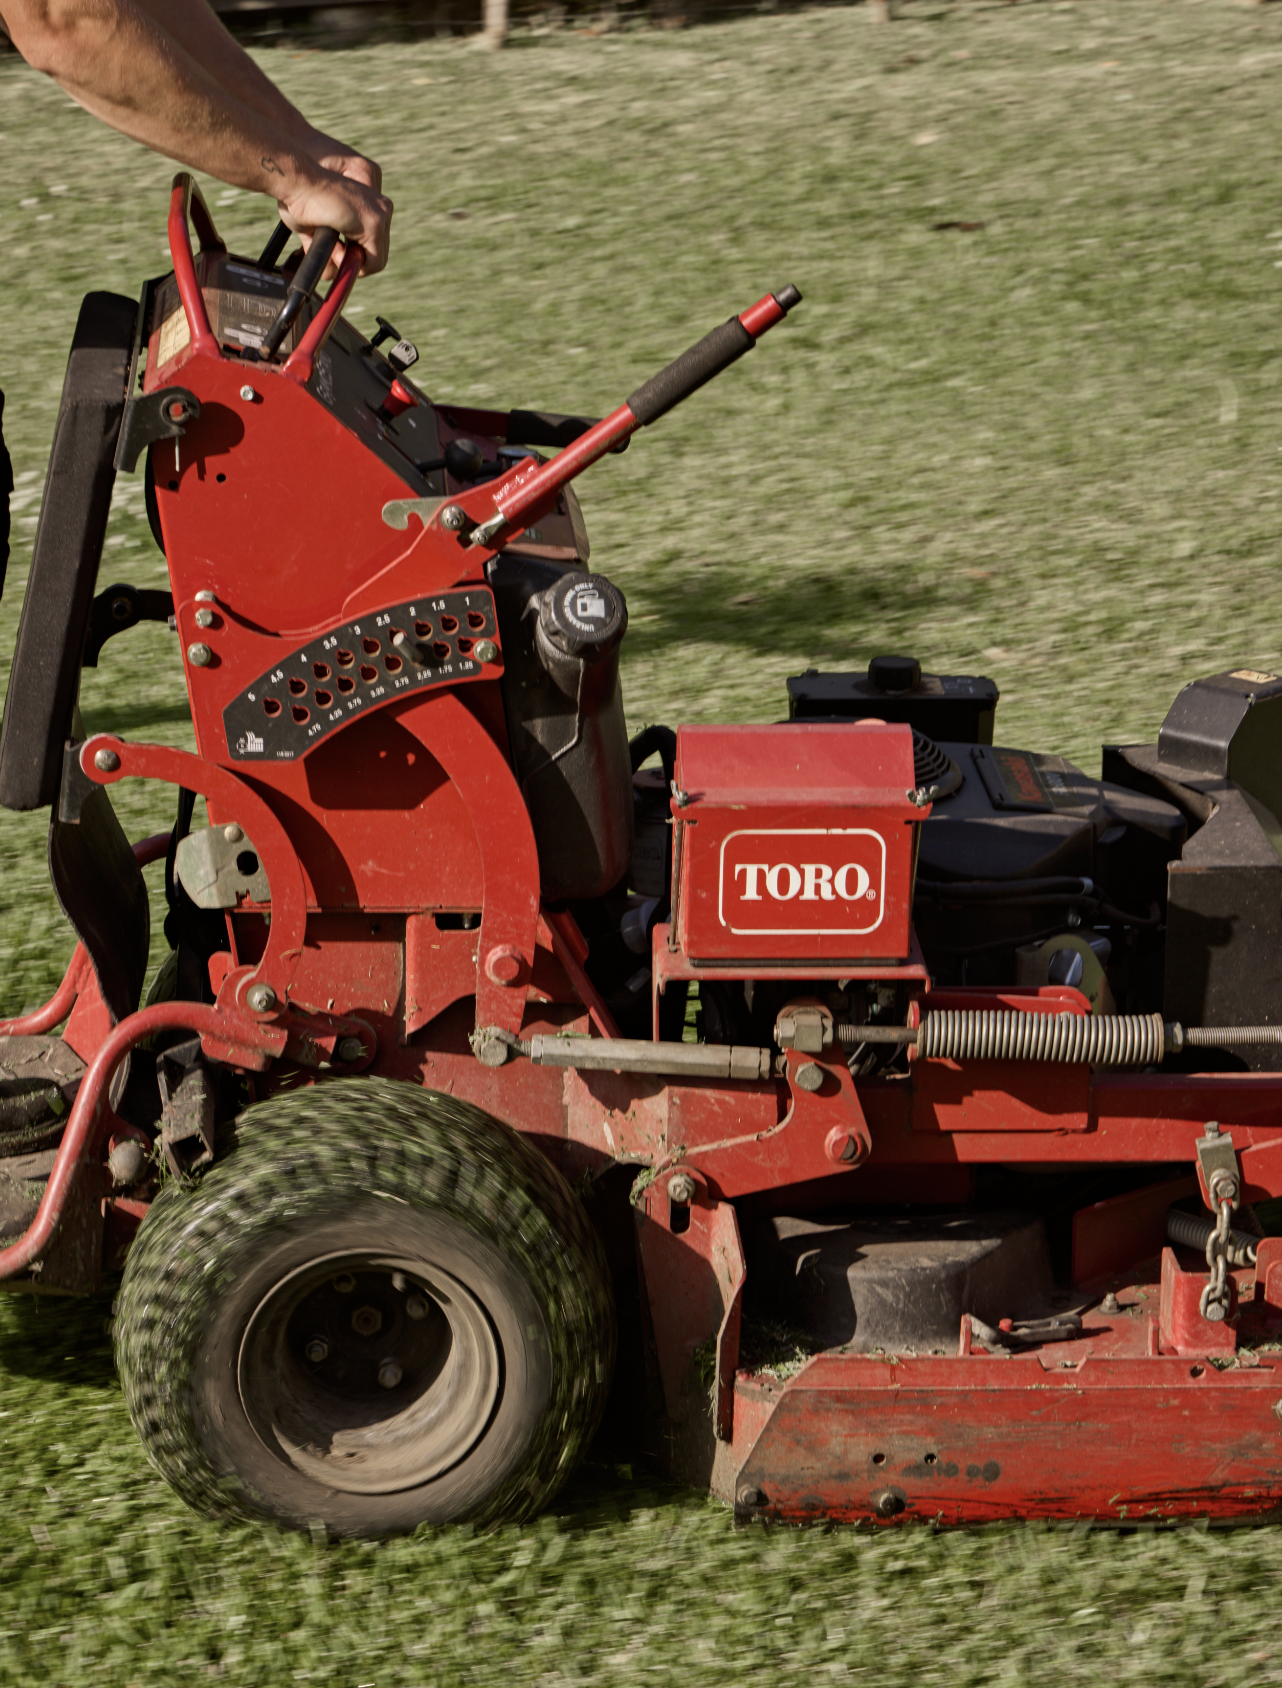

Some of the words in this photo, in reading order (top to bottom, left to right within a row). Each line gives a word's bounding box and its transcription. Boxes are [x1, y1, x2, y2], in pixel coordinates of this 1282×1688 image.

[574, 582, 594, 592] ONLY
[270, 669, 284, 683] 4.5
[300, 653, 307, 663] 4
[323, 636, 338, 650] 3.5
[353, 625, 361, 635] 3
[376, 614, 391, 627] 2.5
[409, 606, 417, 617] 2
[431, 600, 446, 611] 1.5
[464, 596, 470, 606] 1
[438, 664, 453, 675] 1.75
[734, 863, 870, 901] TORO
